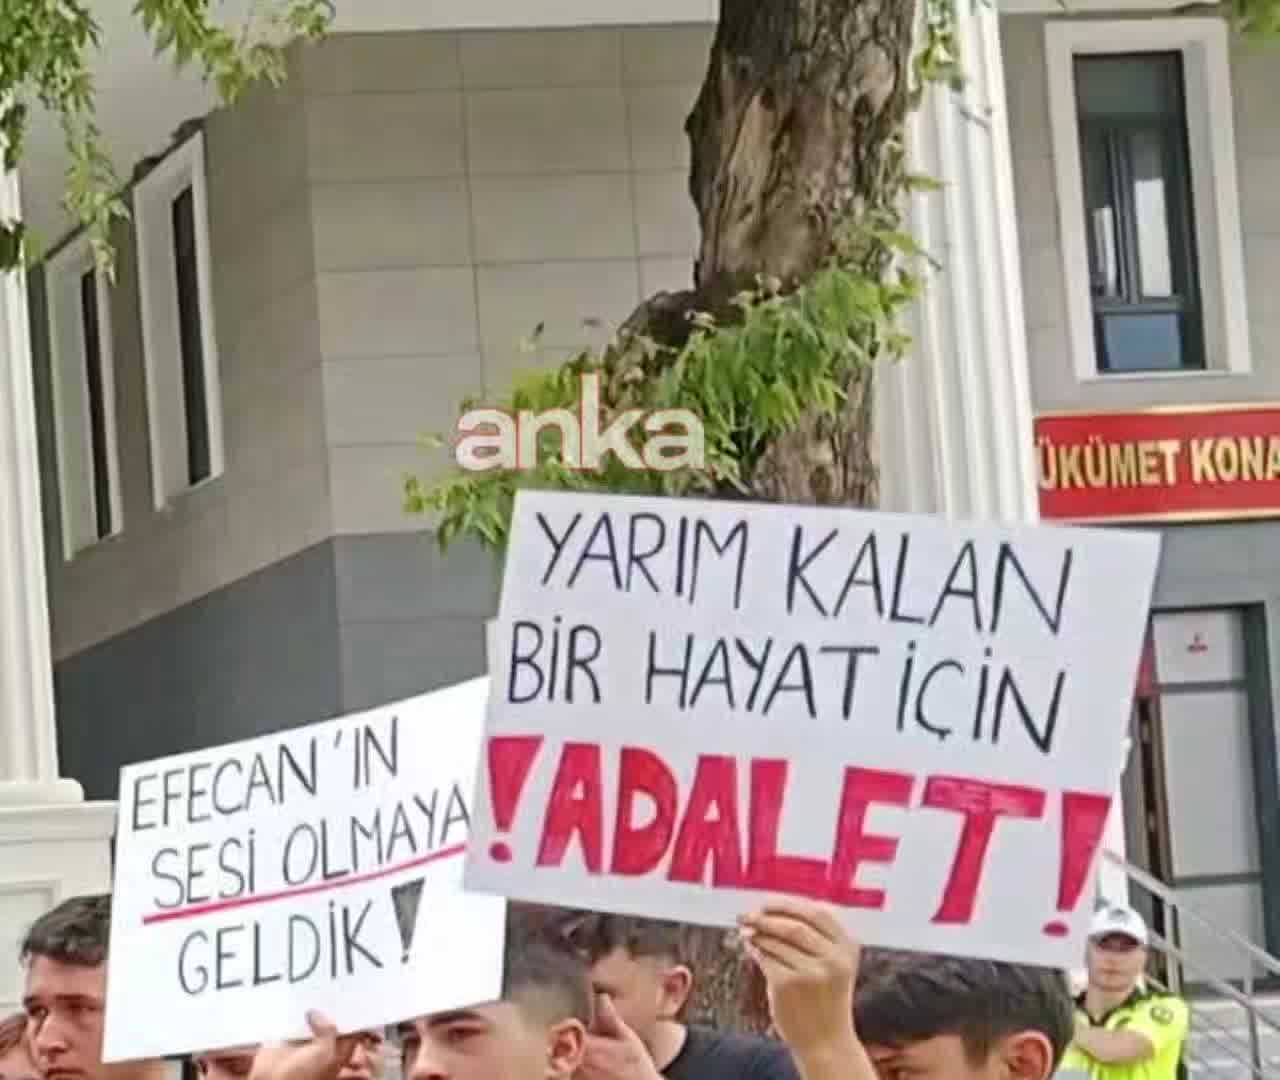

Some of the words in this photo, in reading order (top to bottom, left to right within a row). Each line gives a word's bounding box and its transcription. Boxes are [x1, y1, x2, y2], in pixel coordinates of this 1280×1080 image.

[534, 511, 748, 608] YARIM
[786, 524, 1074, 636] KALAN
[506, 614, 602, 706] BİR
[644, 633, 880, 721] HAYAT
[895, 638, 1066, 754] İÇİN
[131, 716, 399, 832] EFECAN'IN
[151, 828, 257, 910] SESİ
[282, 779, 473, 886] OLMAYA
